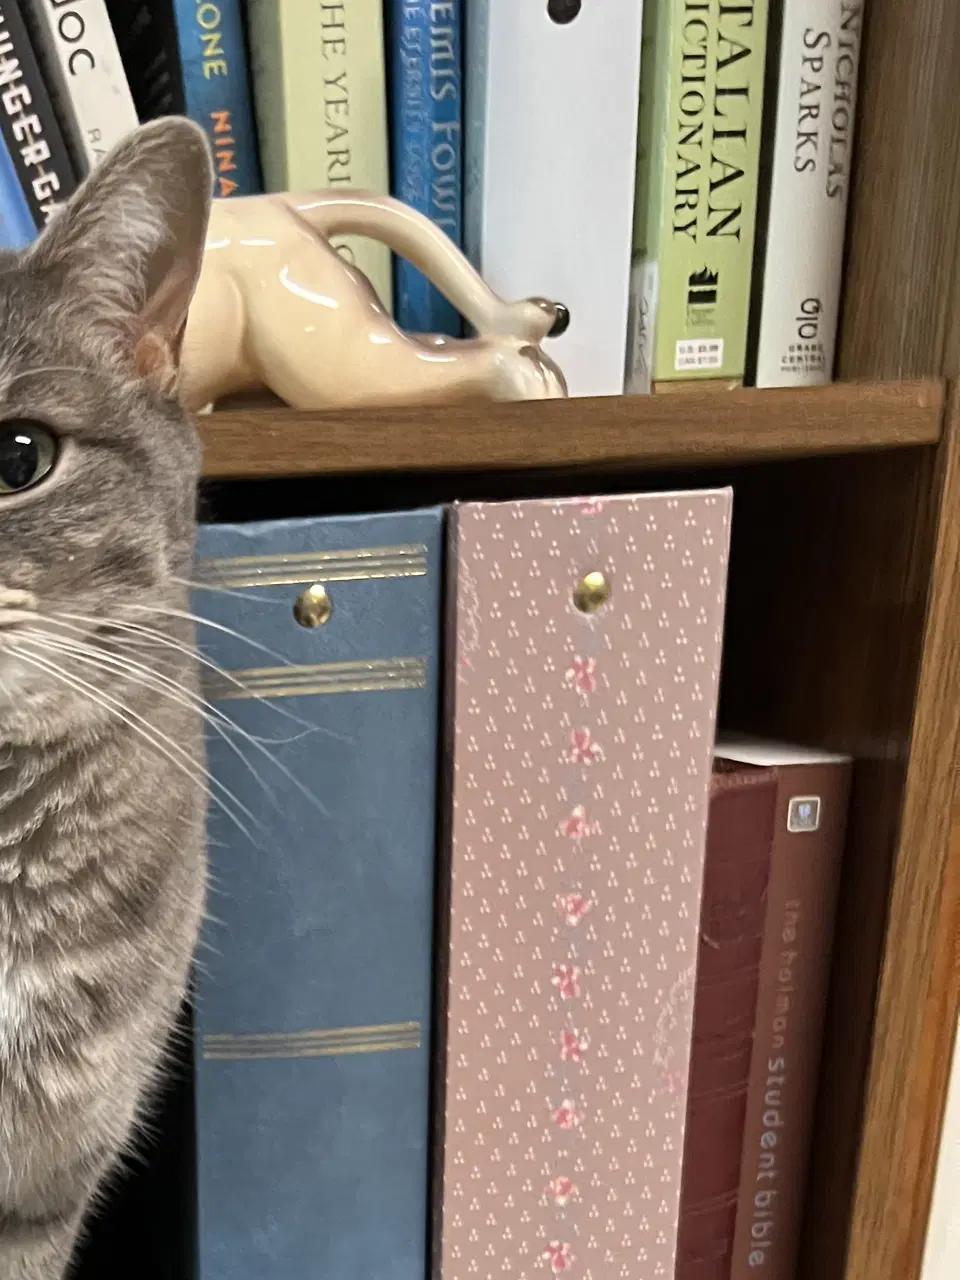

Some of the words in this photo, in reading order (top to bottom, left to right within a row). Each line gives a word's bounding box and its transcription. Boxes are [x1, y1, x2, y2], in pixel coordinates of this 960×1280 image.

[196, 4, 228, 80] ONE
[210, 109, 240, 197] NINA
[672, 1, 710, 244] ICTIONARY
[794, 27, 831, 174] SPARKS
[756, 1056, 786, 1181] student
[748, 1189, 777, 1267] bible
